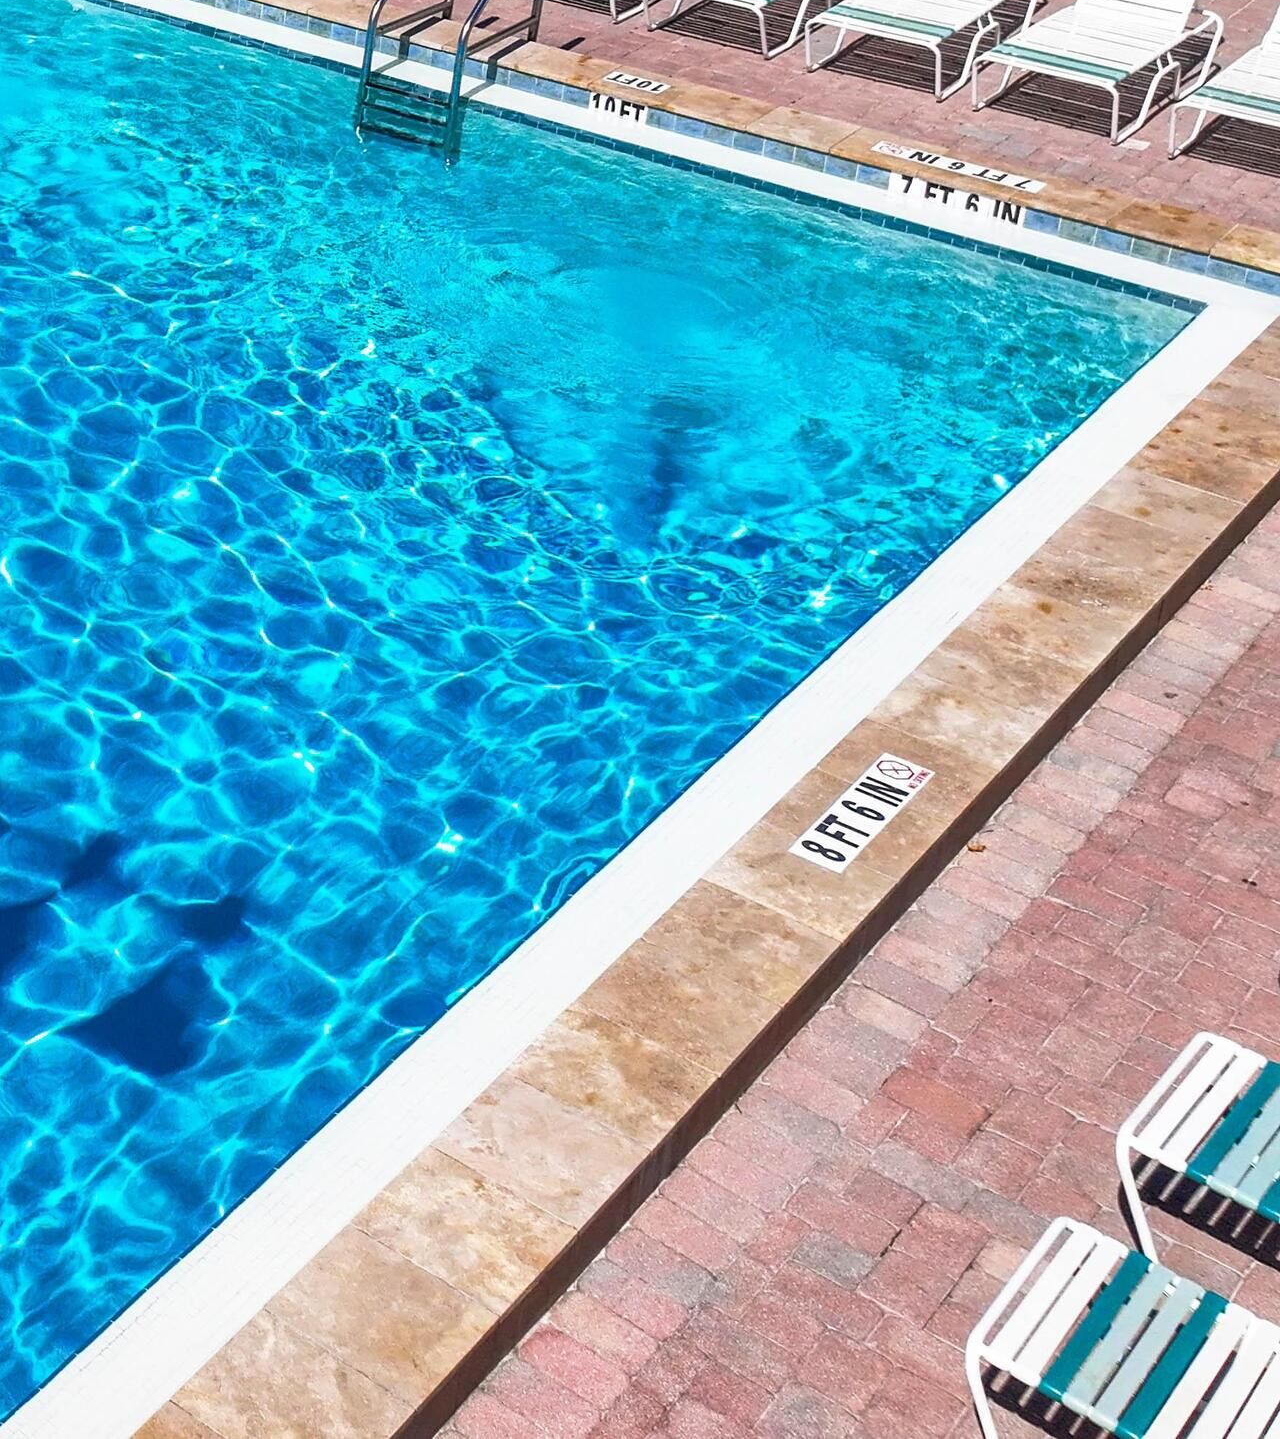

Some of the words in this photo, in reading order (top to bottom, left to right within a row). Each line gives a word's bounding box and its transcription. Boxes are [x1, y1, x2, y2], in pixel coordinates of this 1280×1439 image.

[909, 151, 940, 165] IN
[947, 162, 965, 170] 6
[973, 169, 1008, 182] FT
[1014, 179, 1033, 189] 7
[901, 174, 913, 194] 7
[925, 181, 955, 204] FT
[965, 193, 980, 212] 6
[992, 199, 1021, 225] IN
[854, 776, 910, 807] IN
[841, 800, 886, 821] 6
[814, 814, 871, 849] FT
[801, 840, 846, 862] 8
